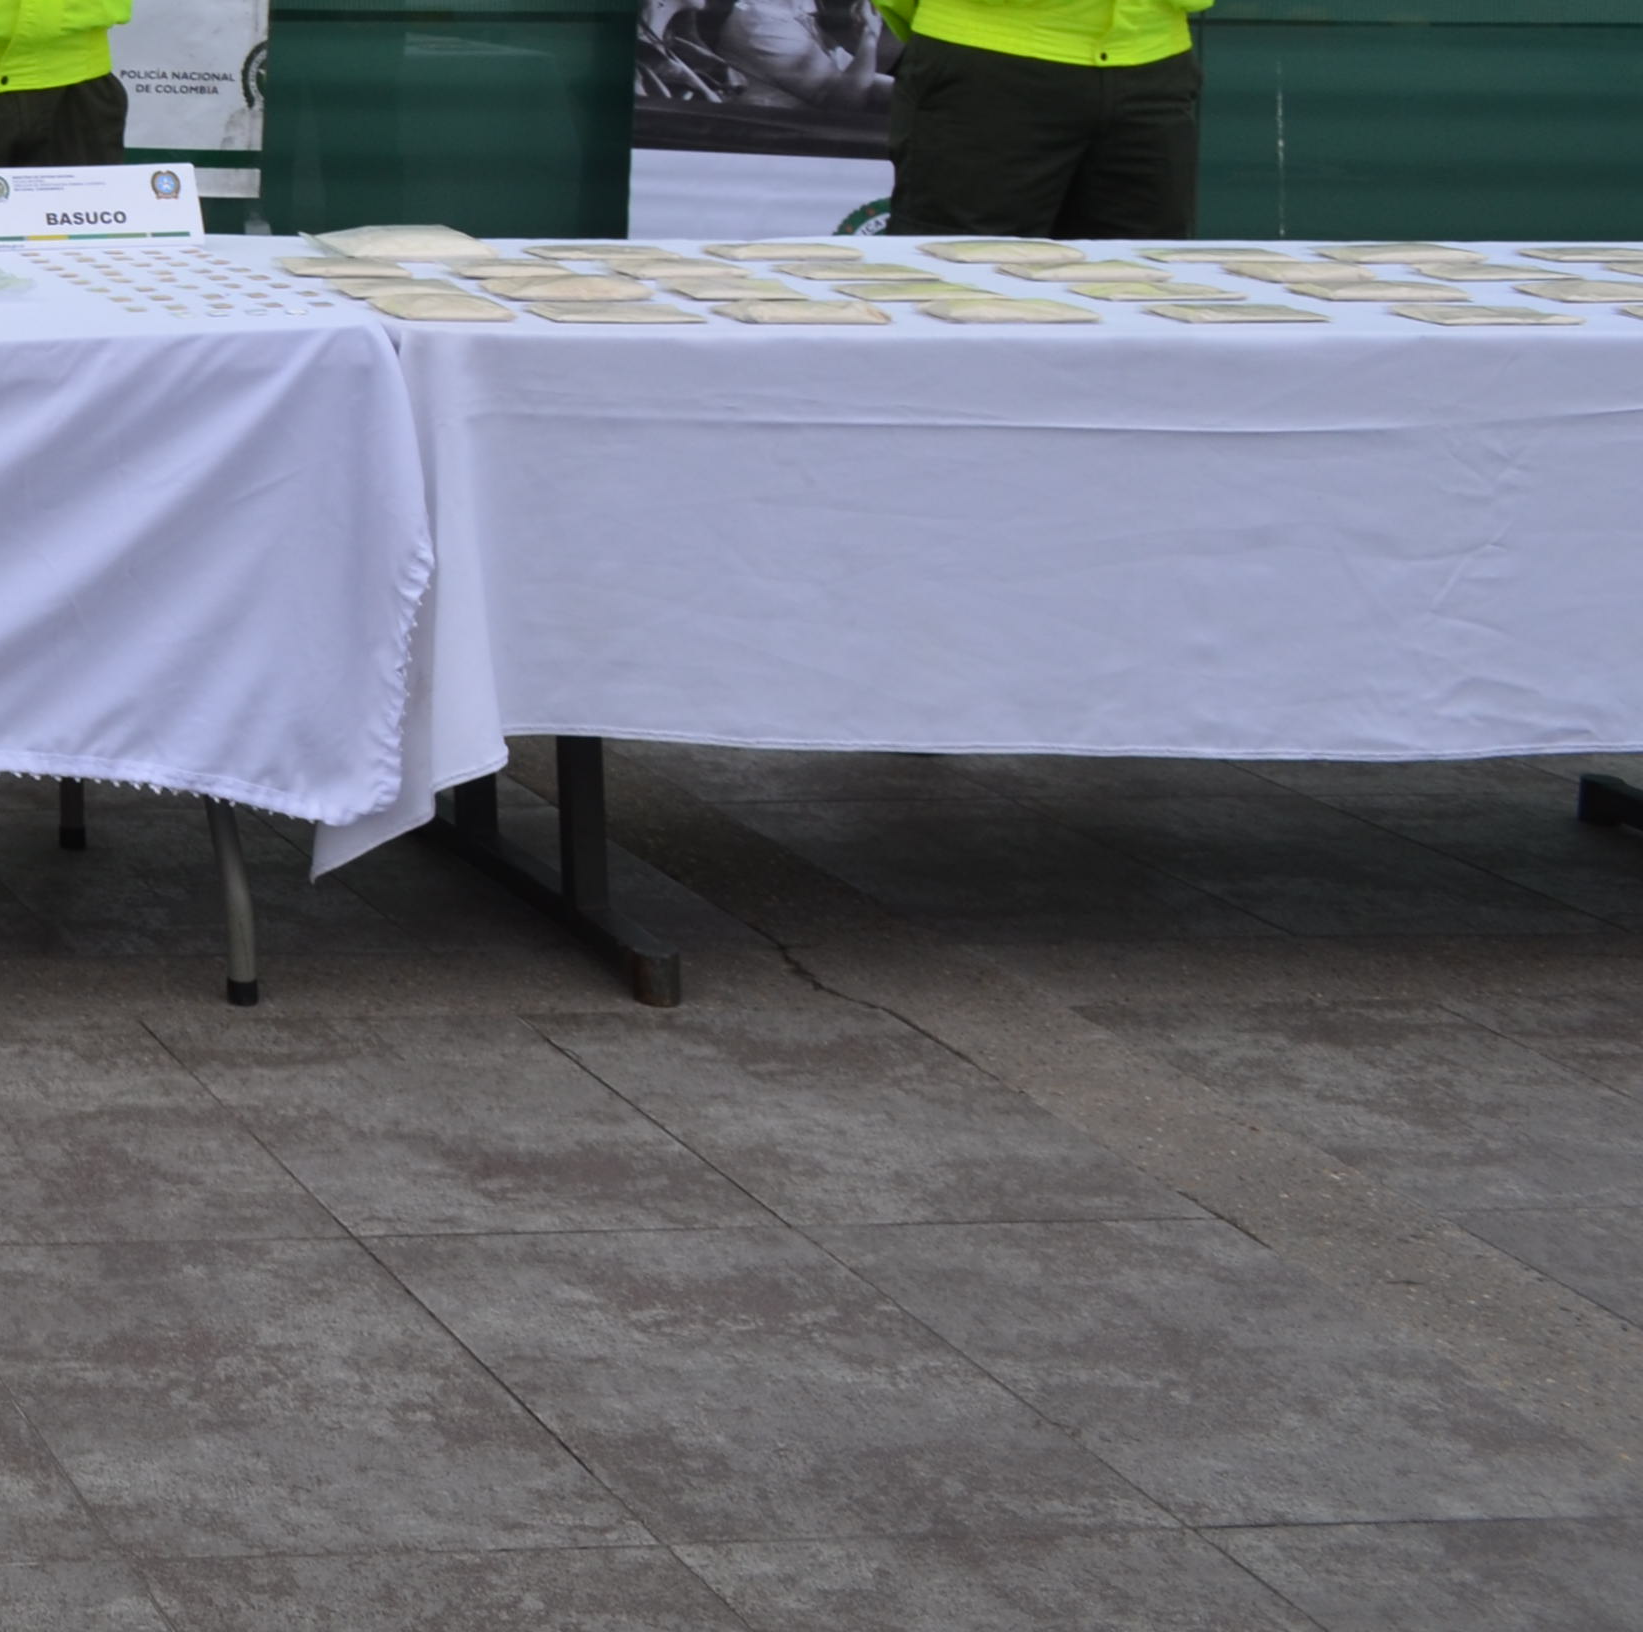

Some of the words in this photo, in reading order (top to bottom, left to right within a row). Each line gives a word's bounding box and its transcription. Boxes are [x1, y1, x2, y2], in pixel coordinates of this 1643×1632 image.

[119, 69, 169, 80] POLICÍA
[171, 71, 236, 82] NACIONAL
[135, 83, 151, 94] DE
[154, 83, 219, 95] COLOMBIA
[45, 210, 127, 226] BASUCO
